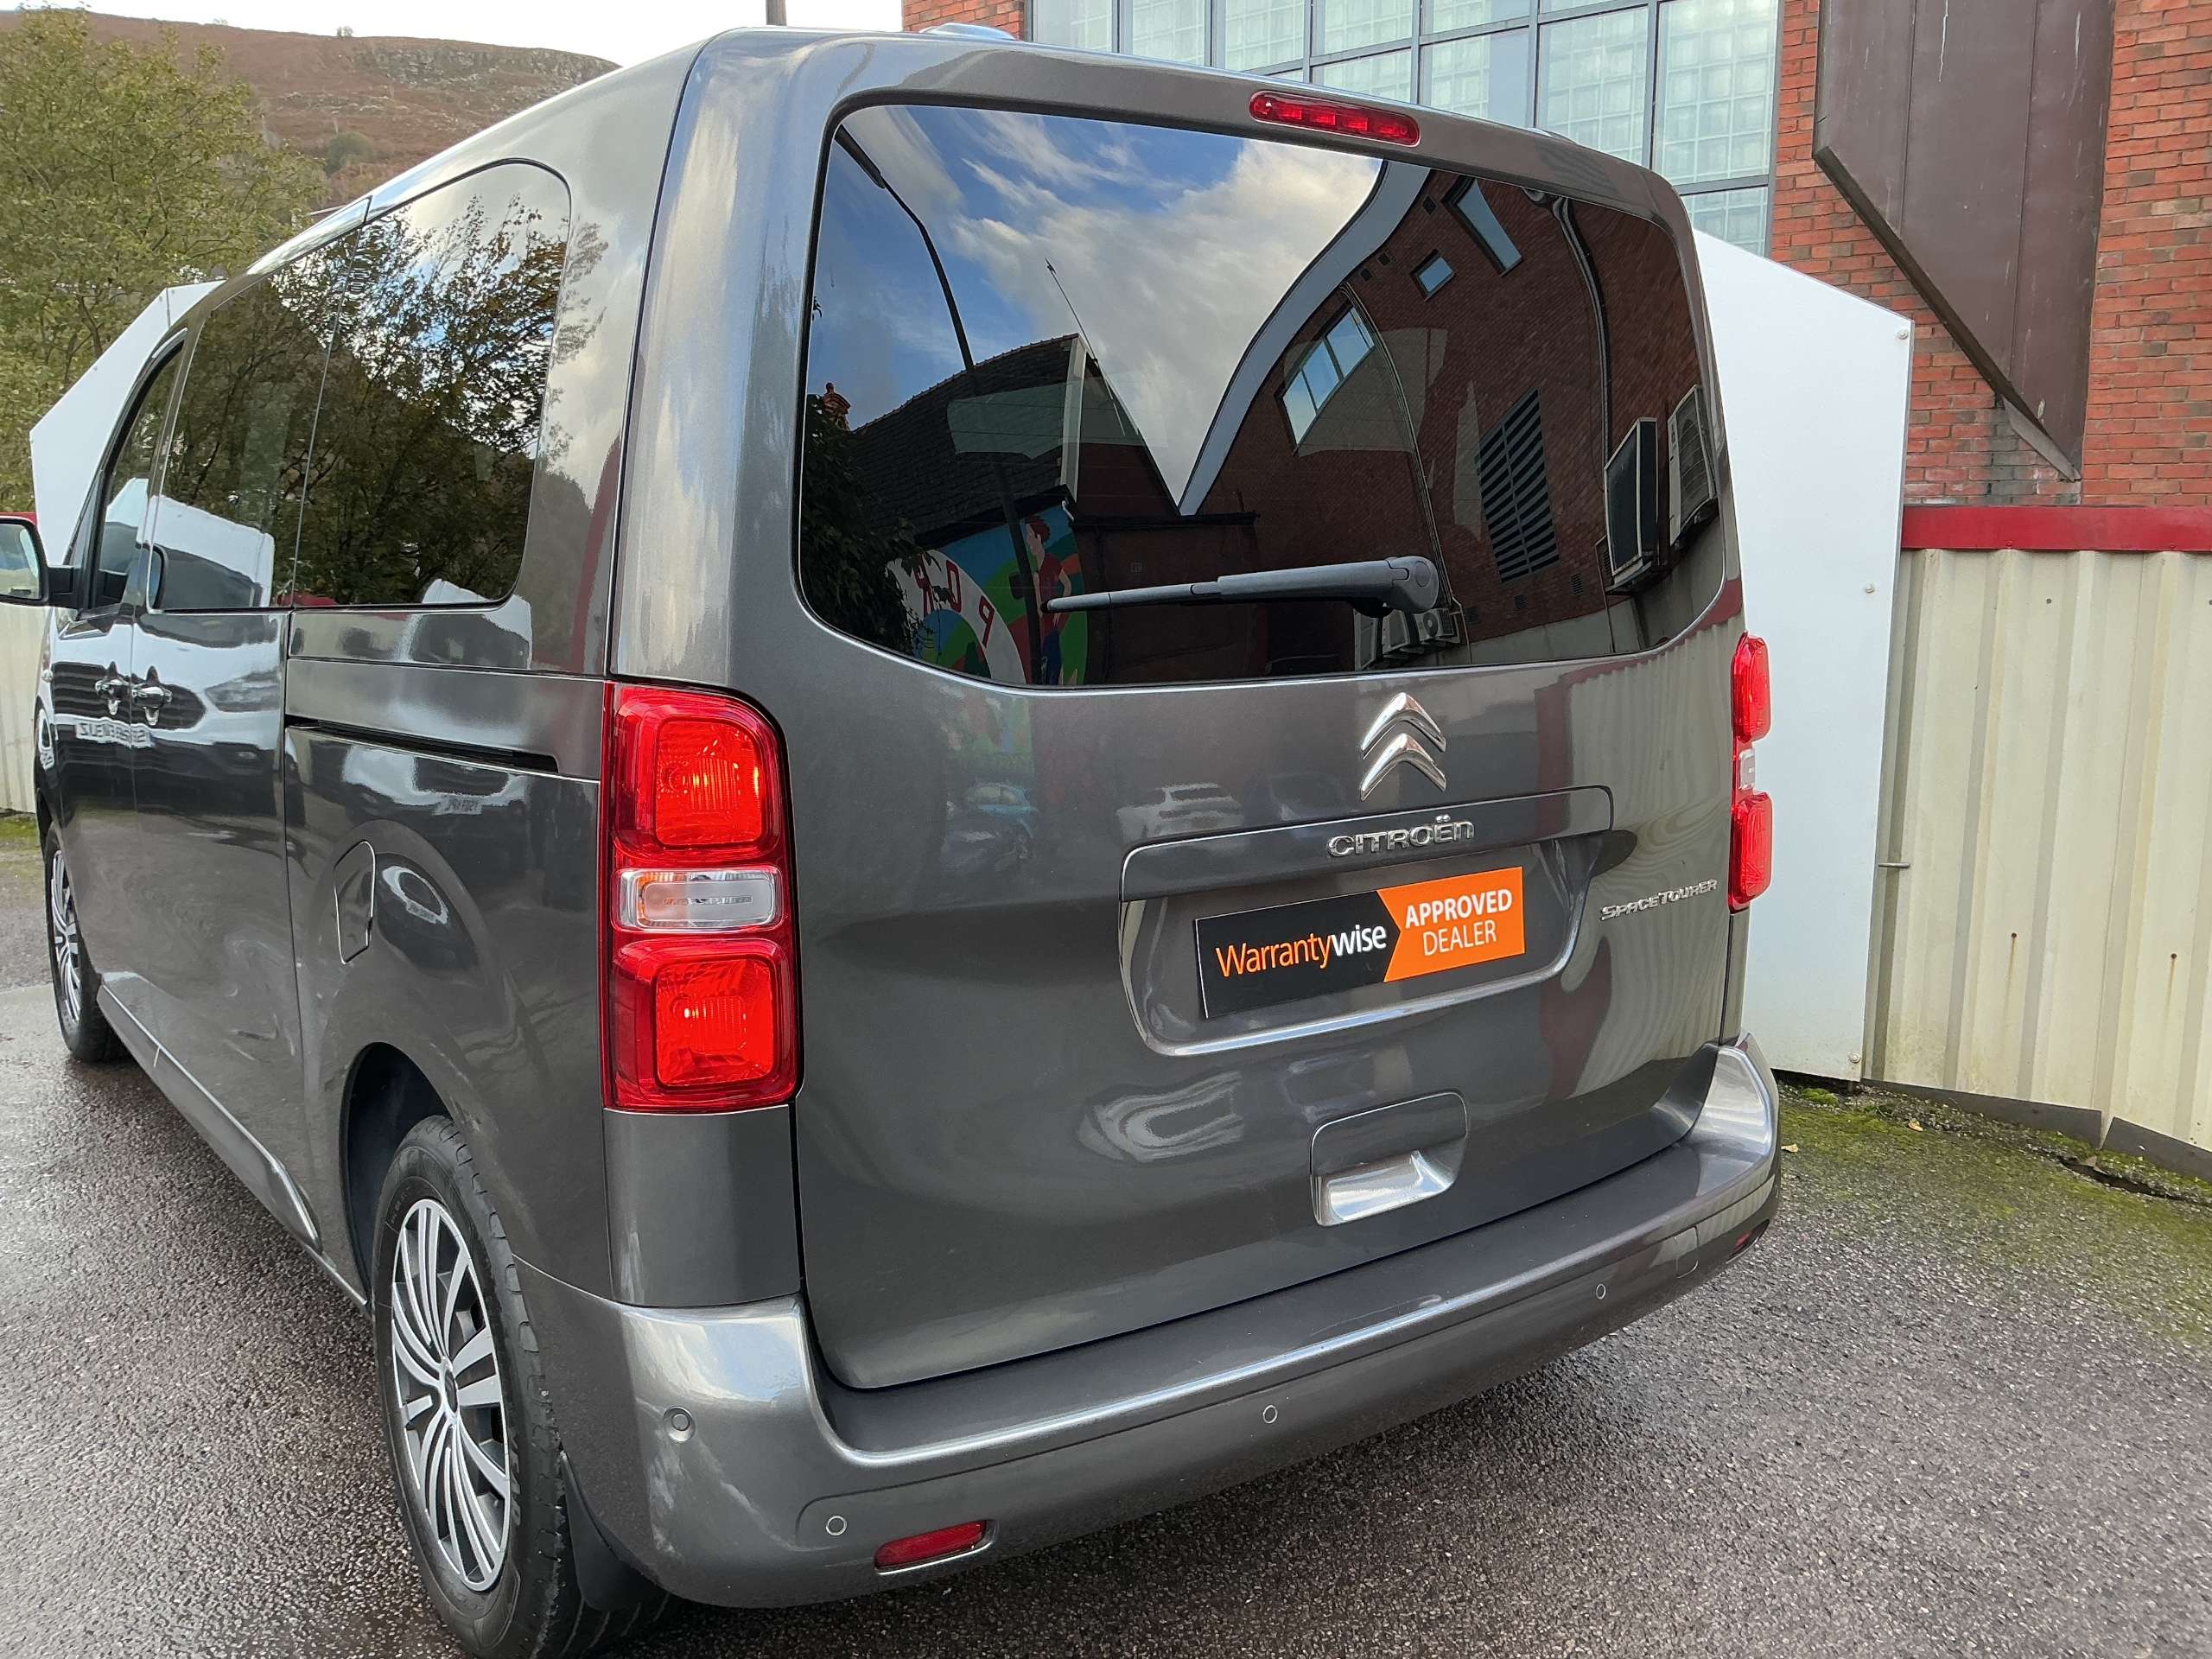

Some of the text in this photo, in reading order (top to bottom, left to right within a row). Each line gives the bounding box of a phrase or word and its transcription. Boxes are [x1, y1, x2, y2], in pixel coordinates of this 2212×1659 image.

[1405, 888, 1513, 929] APPROVED
[1215, 924, 1388, 978] Warrantywise
[1422, 919, 1497, 957] DEALER
